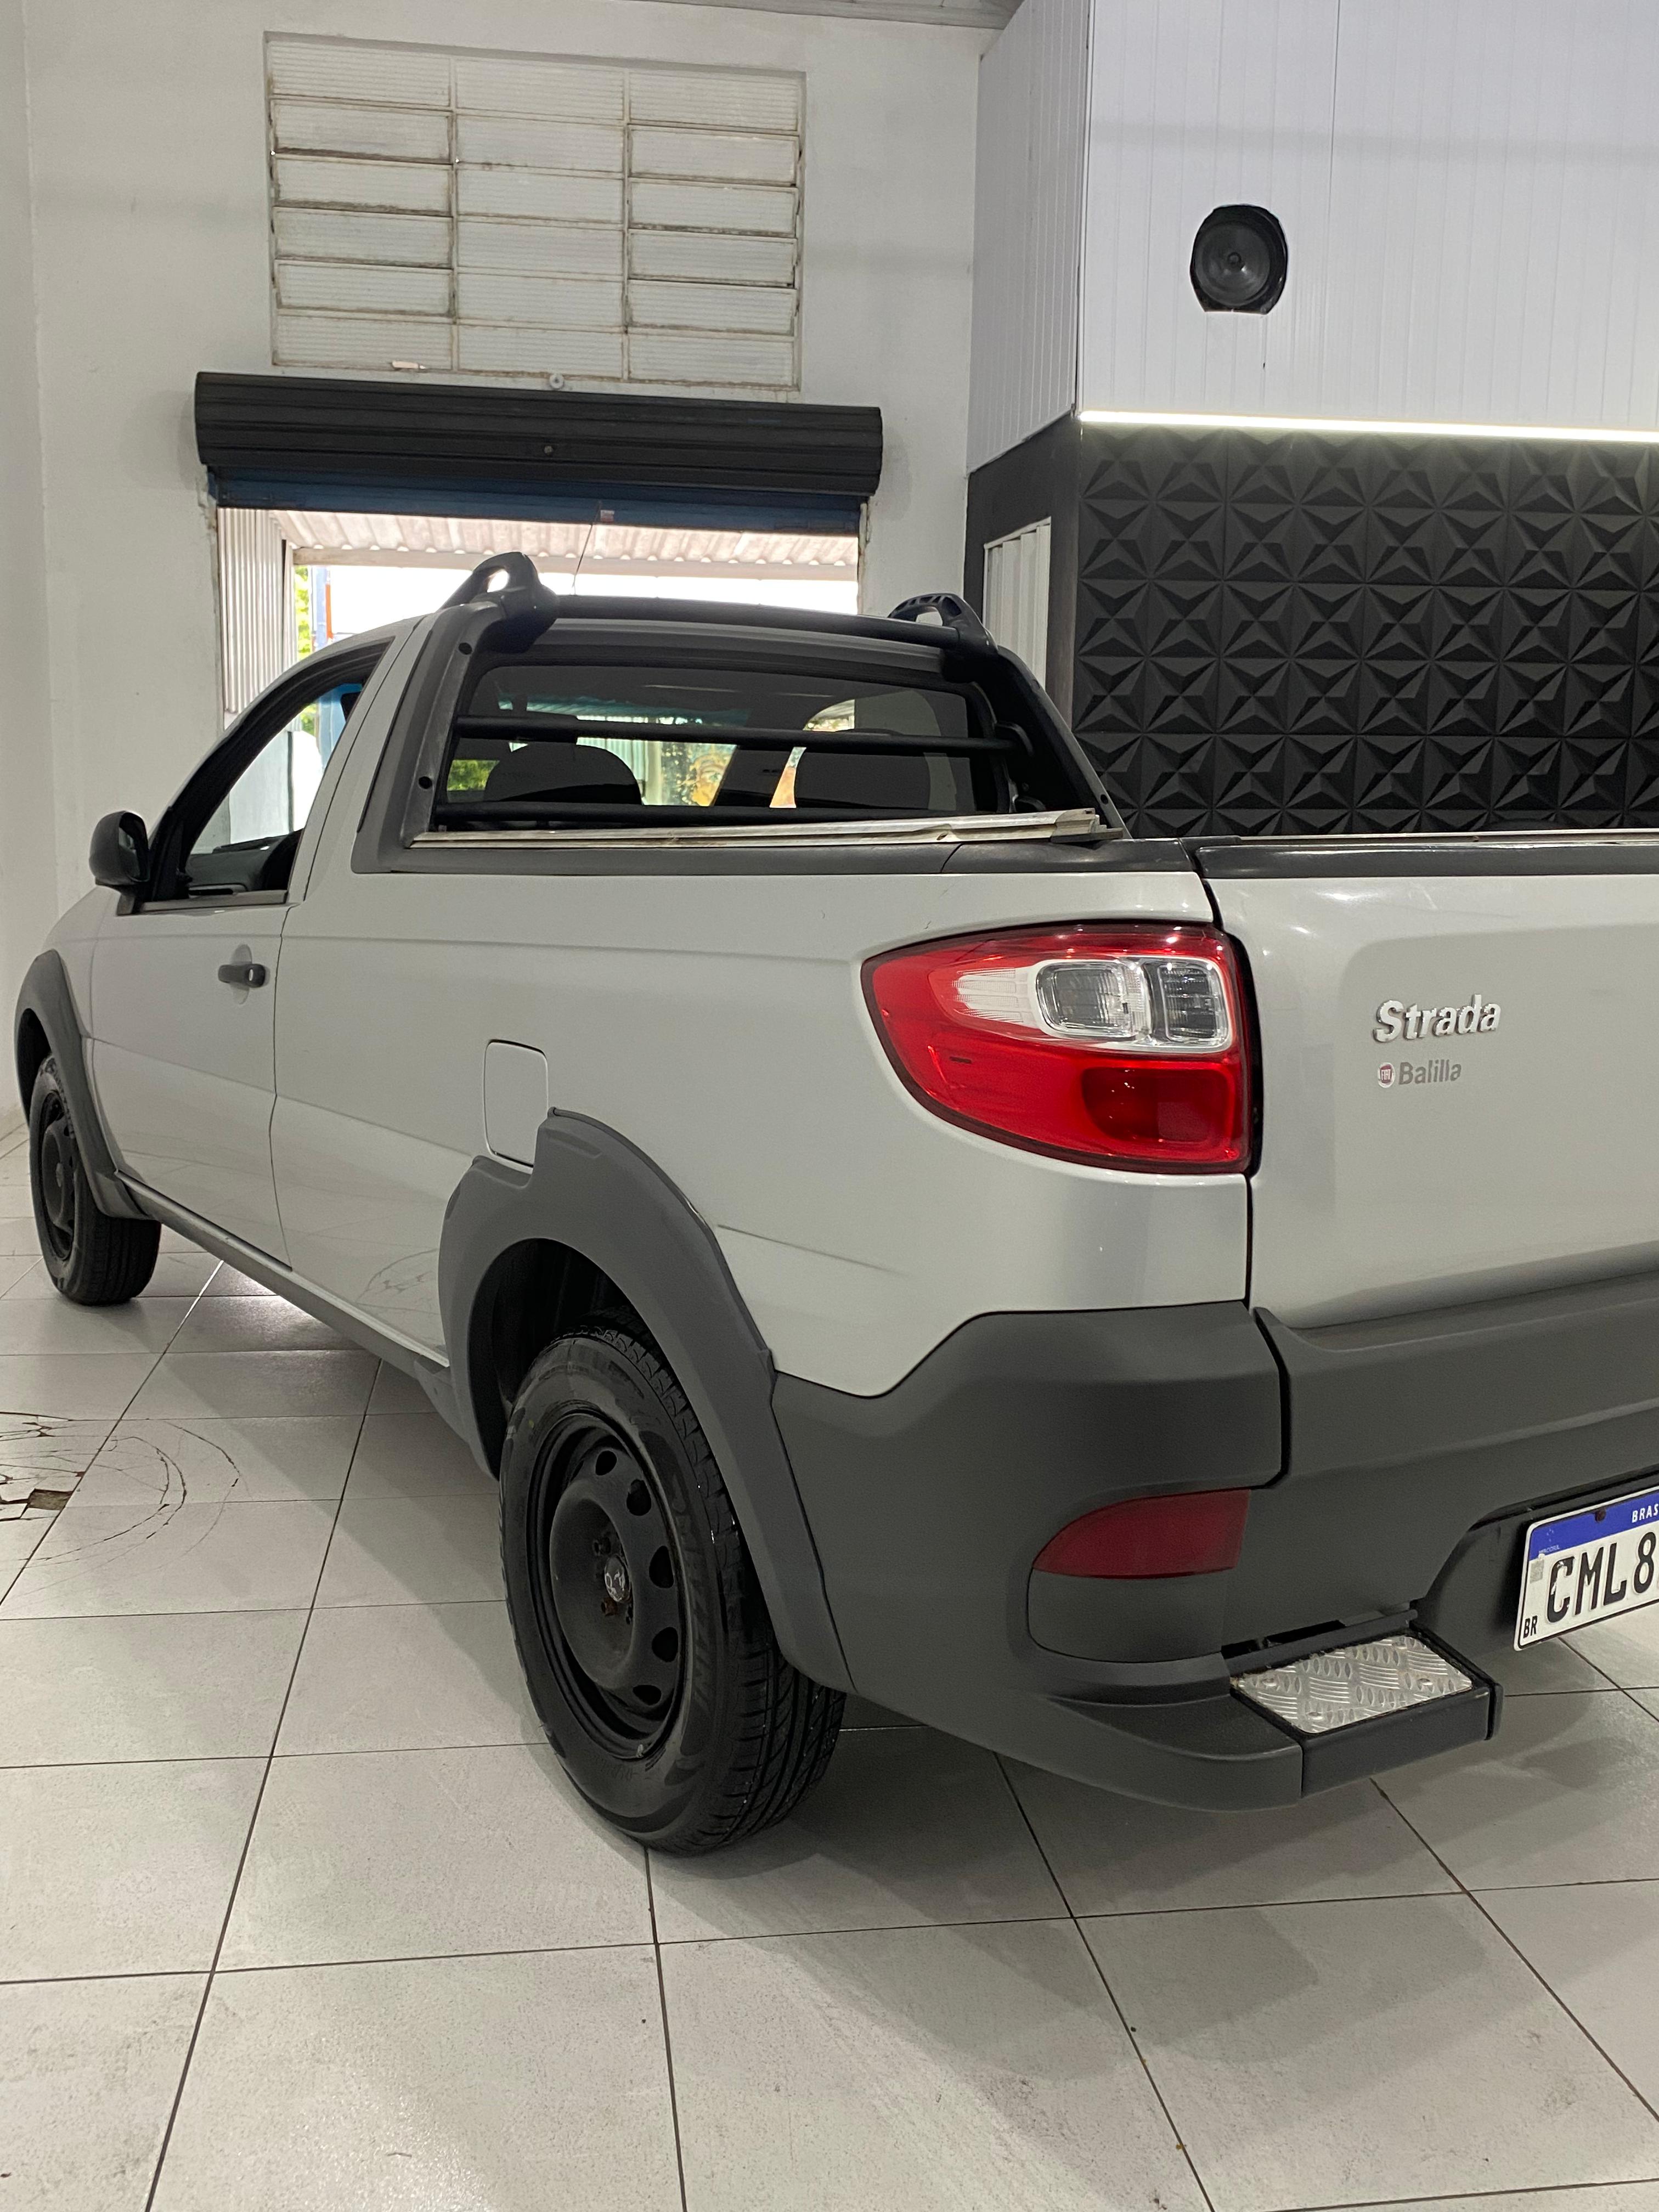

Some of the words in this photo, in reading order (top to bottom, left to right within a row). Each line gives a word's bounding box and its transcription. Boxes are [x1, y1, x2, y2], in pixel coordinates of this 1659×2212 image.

[1373, 994, 1502, 1043] Strada
[1398, 1059, 1462, 1086] Balilla
[1547, 1531, 1657, 1623] CML8
[1523, 1615, 1538, 1639] BR
